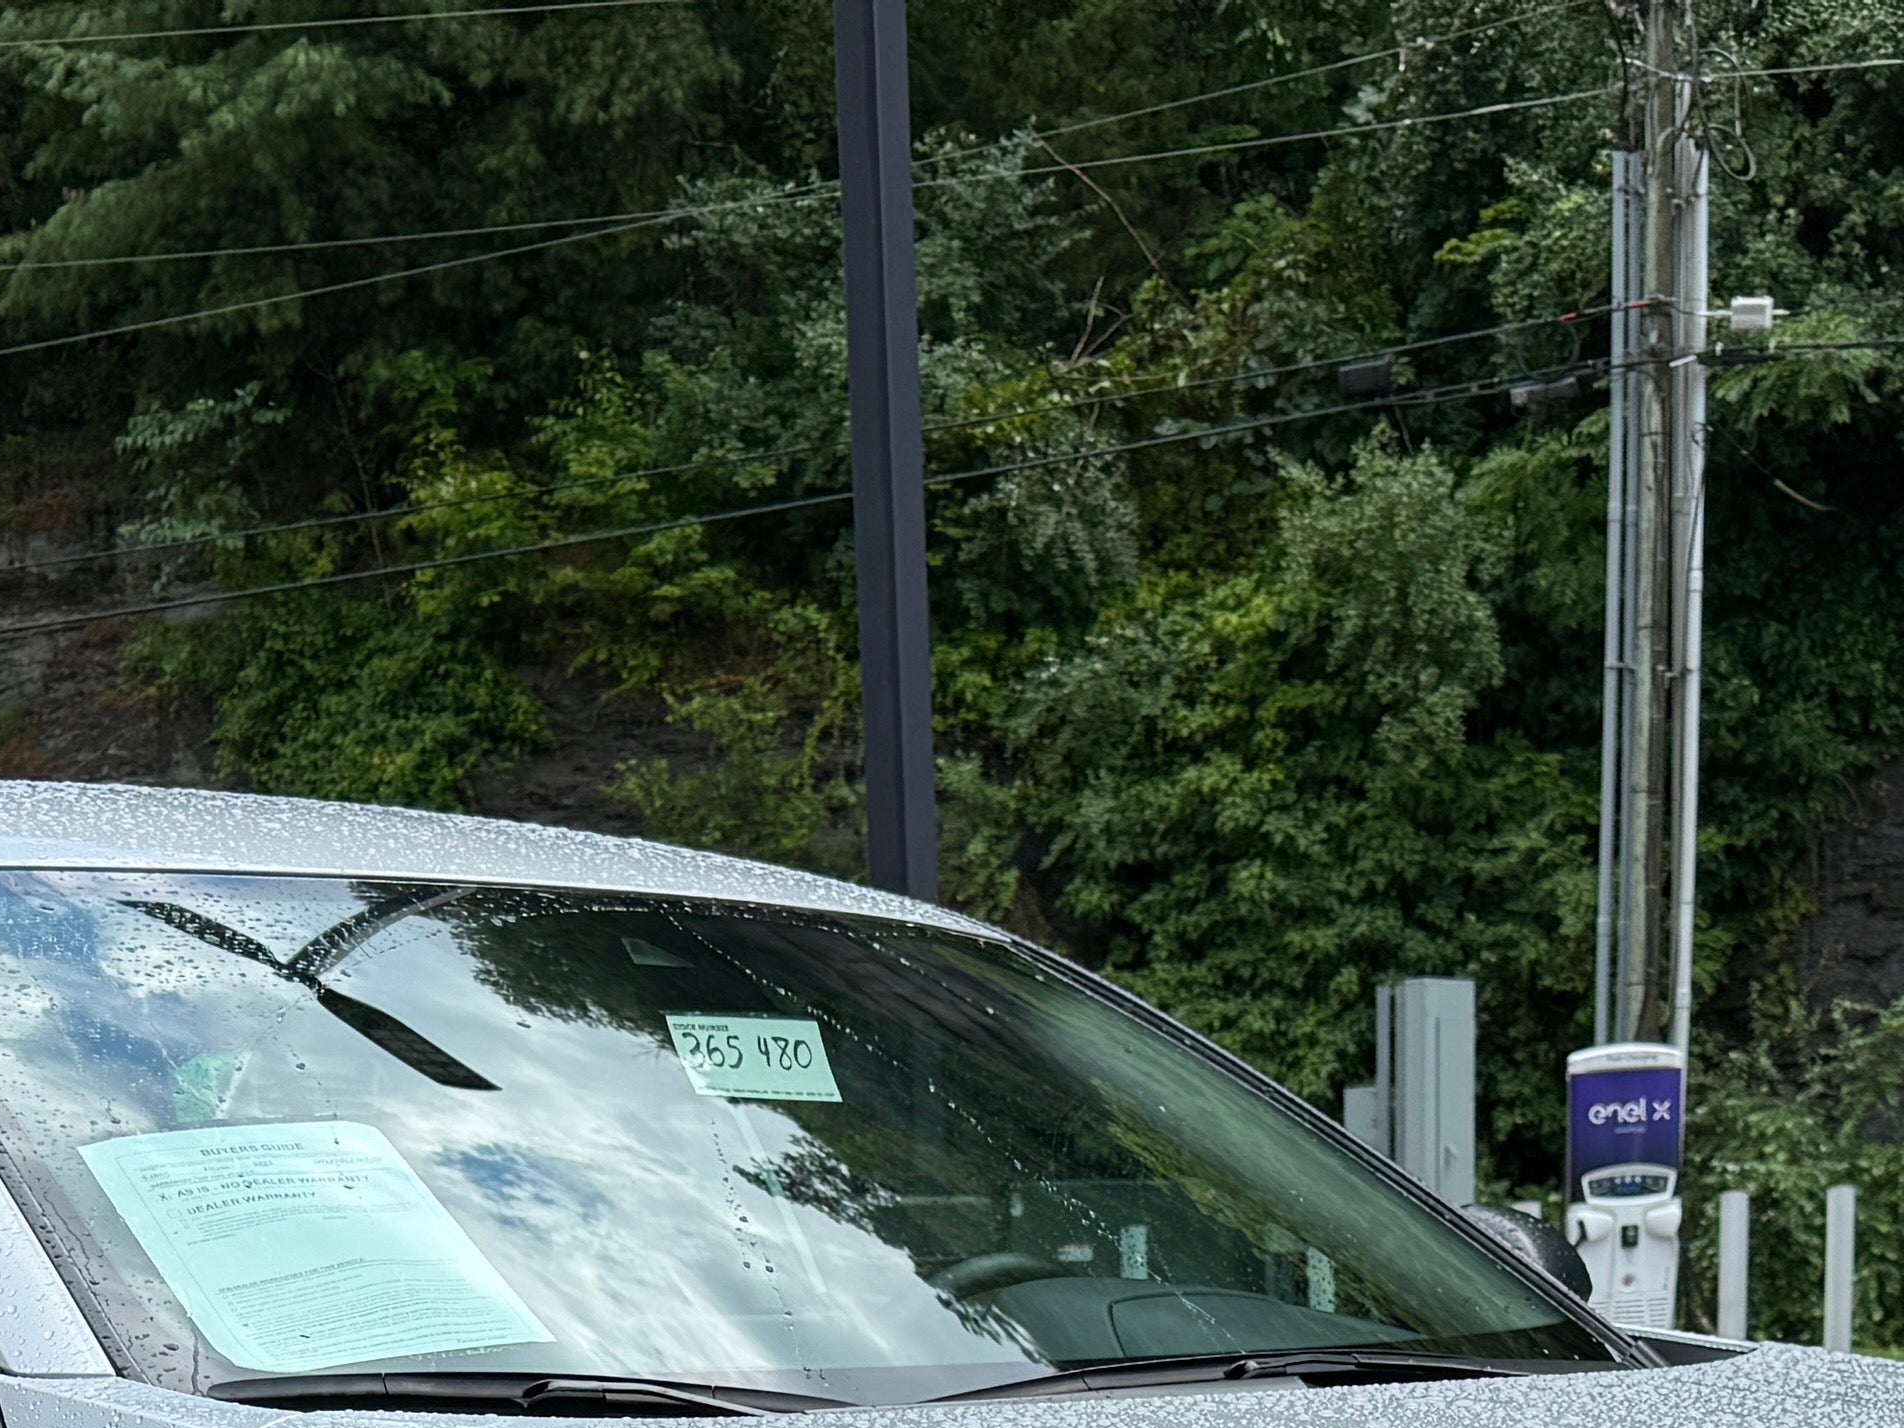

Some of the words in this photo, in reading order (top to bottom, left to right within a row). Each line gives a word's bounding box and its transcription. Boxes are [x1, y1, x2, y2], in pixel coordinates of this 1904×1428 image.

[757, 1035, 813, 1071] 480
[1588, 1097, 1646, 1125] enel
[199, 1145, 258, 1157] BUYERS
[260, 1142, 305, 1152] GUIDE
[178, 1188, 195, 1197] AS
[197, 1185, 211, 1193] IS
[221, 1180, 241, 1190] NO
[243, 1177, 295, 1188] DEALER
[297, 1174, 369, 1185] WARRANTY
[186, 1198, 241, 1215] DEALER
[242, 1191, 316, 1204] WARRANTY
